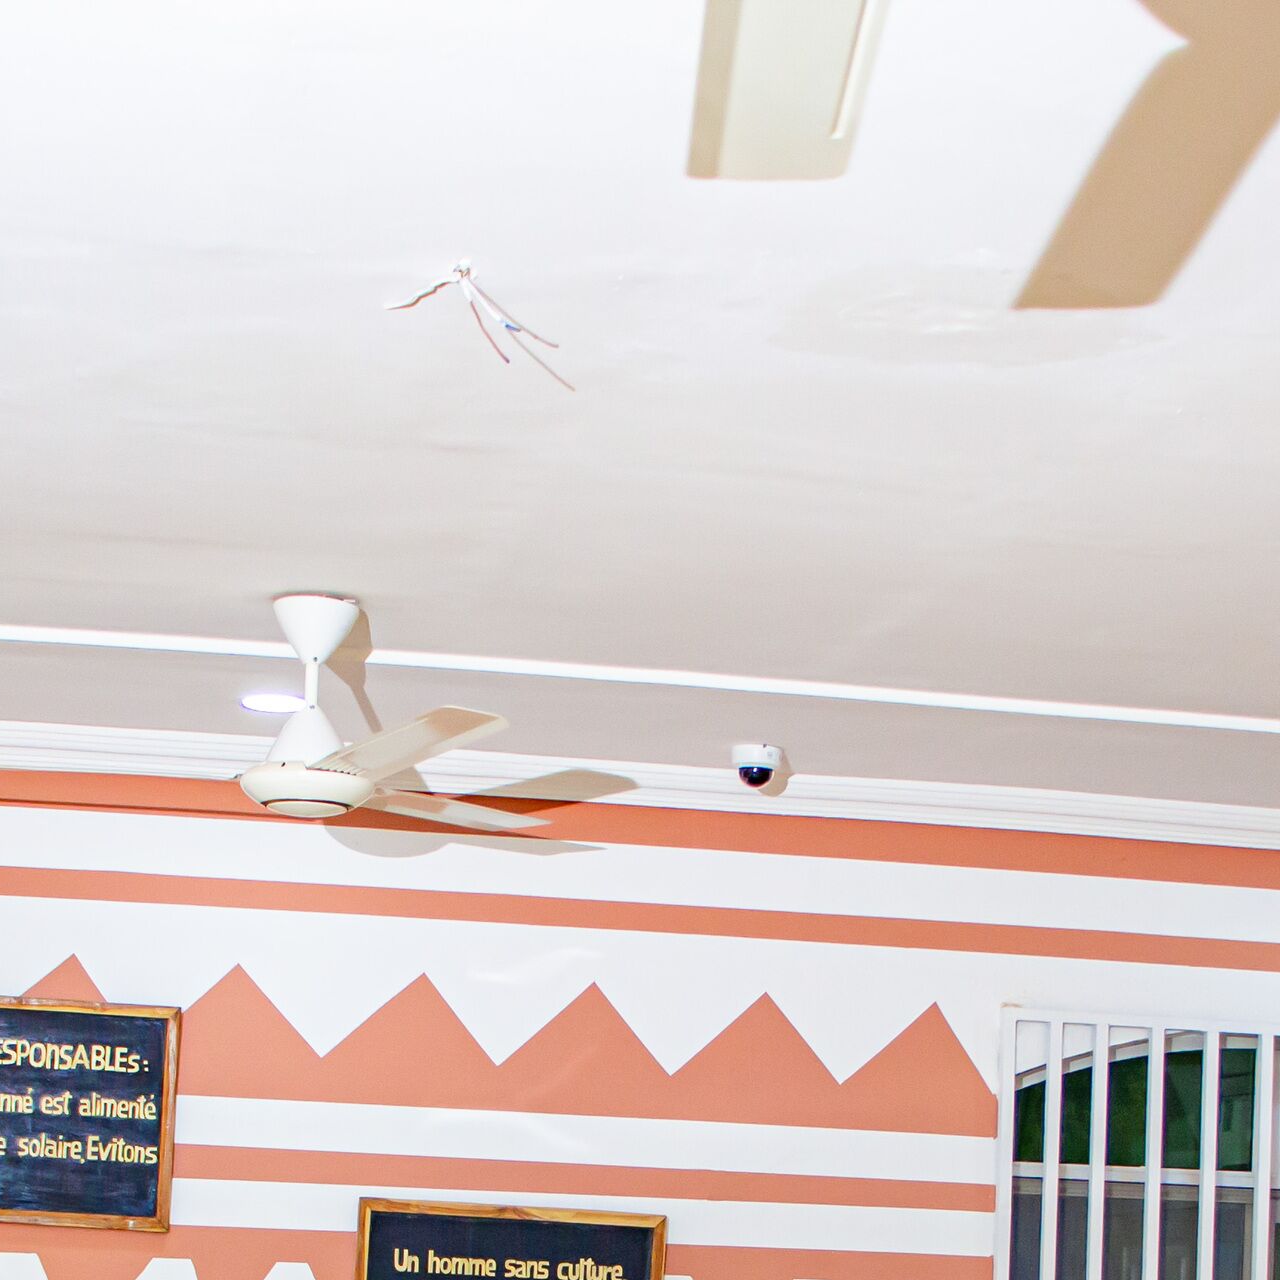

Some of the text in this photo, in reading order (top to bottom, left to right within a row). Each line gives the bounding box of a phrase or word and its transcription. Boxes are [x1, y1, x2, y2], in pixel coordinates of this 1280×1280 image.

[40, 1090, 73, 1116] est
[78, 1091, 157, 1120] alimenté
[393, 1248, 420, 1273] Un
[427, 1249, 497, 1278] homme
[504, 1257, 550, 1279] sans
